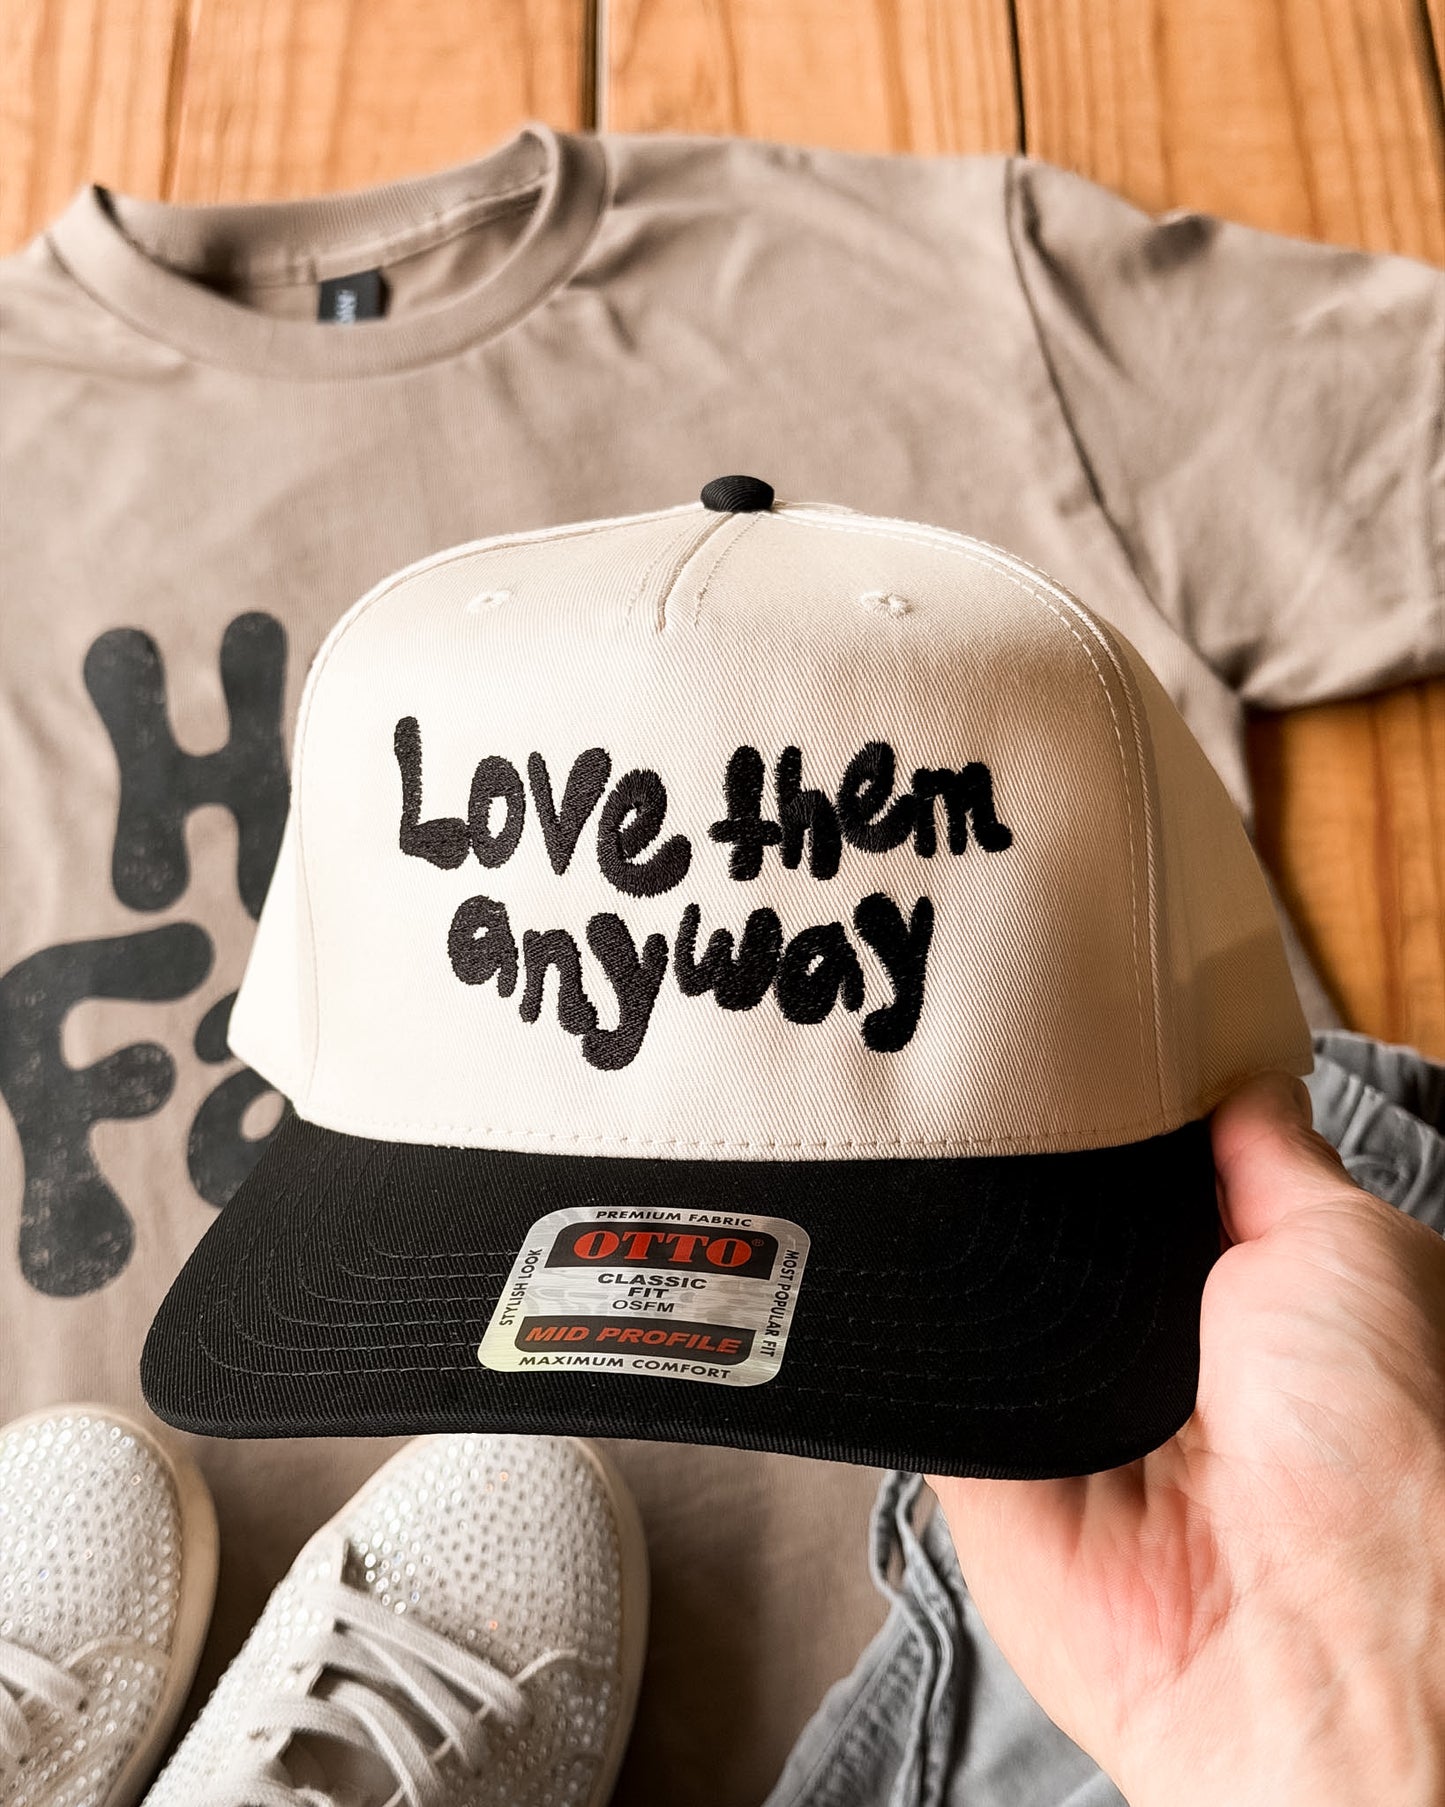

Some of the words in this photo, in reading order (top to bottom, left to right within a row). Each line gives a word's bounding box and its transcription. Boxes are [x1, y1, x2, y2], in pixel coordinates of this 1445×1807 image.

[394, 716, 692, 898] Love
[708, 741, 1012, 881] them
[448, 893, 934, 1070] anyway
[596, 1210, 681, 1222] PREMIUM
[688, 1213, 752, 1227] FABRIC
[780, 1249, 800, 1282] MOST
[499, 1282, 528, 1326] STYLISH
[519, 1248, 543, 1280] LOOK
[597, 1273, 708, 1290] CLASSIC
[627, 1286, 670, 1299] FIT
[612, 1299, 675, 1313] OSFM
[765, 1283, 791, 1338] POPULAR
[525, 1326, 590, 1342] MID
[596, 1328, 742, 1355] PROFILE
[761, 1340, 778, 1357] FIT
[518, 1356, 624, 1368] MAXIMUM
[632, 1359, 731, 1379] COMFORT
